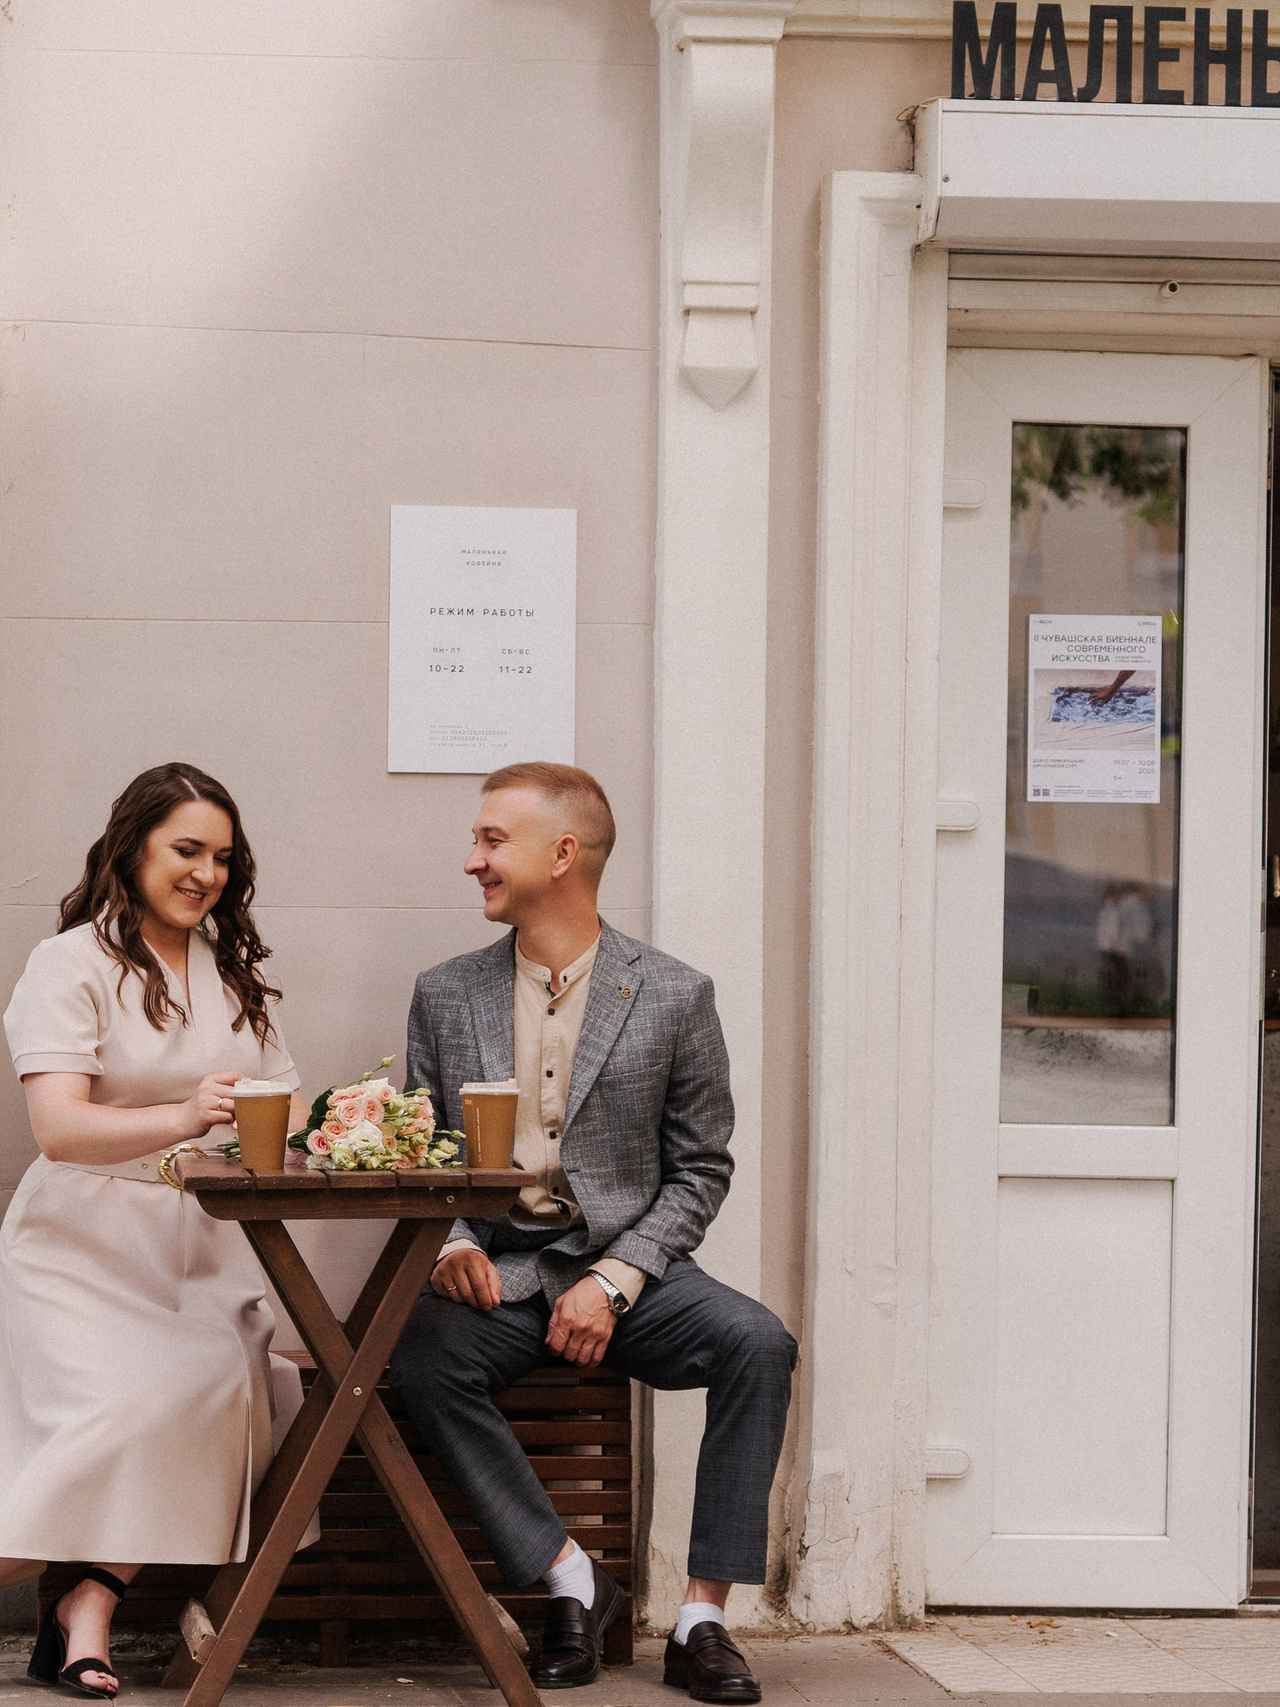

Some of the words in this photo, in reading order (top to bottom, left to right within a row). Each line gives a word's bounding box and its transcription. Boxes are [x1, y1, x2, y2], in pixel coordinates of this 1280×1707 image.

[430, 607, 474, 616] РЕЖИМ
[482, 608, 534, 617] РАБОТЫ
[1041, 634, 1103, 642] ЧУВАШСКАЯ
[1105, 635, 1157, 644] БИЕННАЛЕ
[1066, 644, 1146, 654] СОВРЕМЕННОГО
[1051, 654, 1110, 663] ИСКУССТВА
[1138, 767, 1156, 775] 2025
